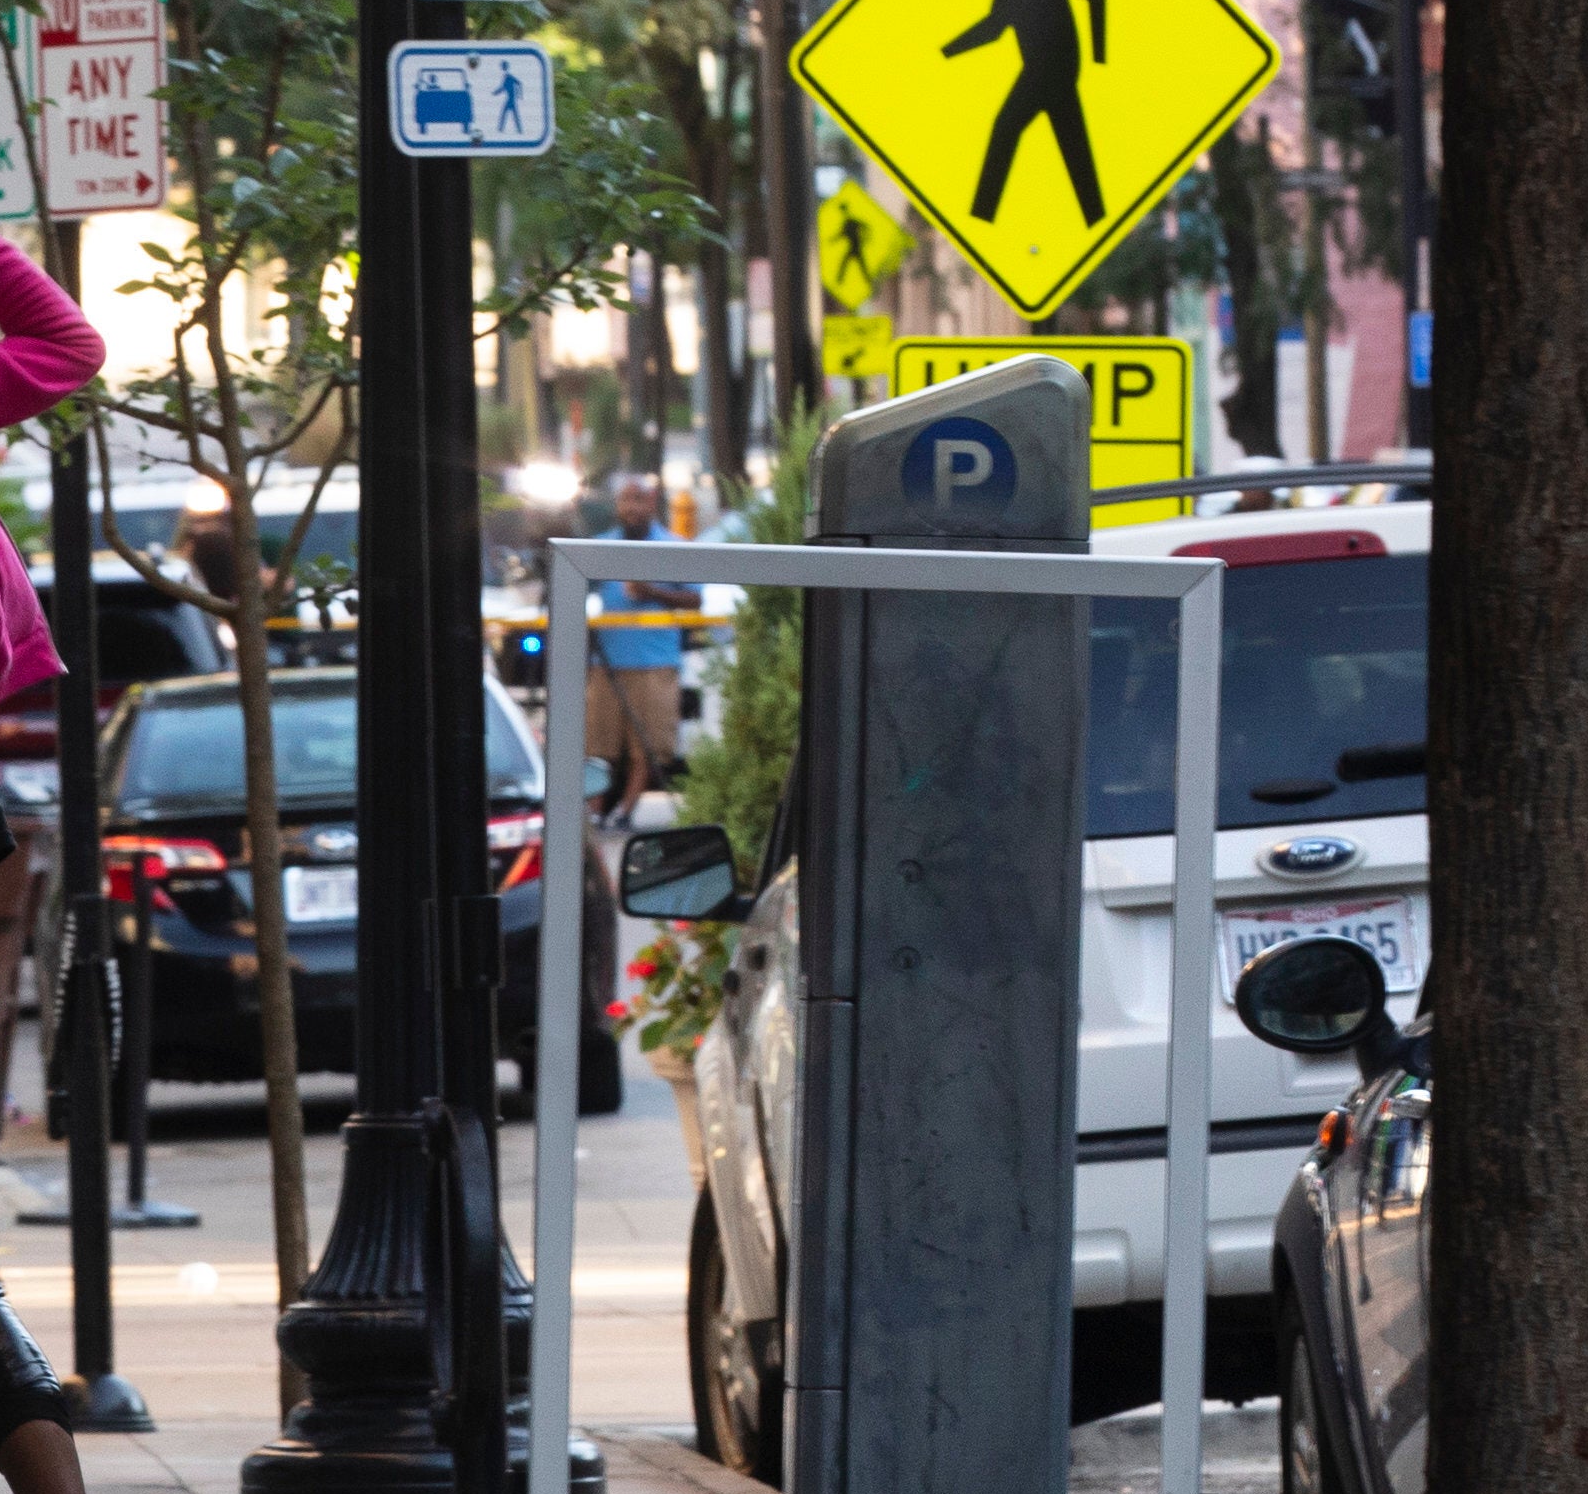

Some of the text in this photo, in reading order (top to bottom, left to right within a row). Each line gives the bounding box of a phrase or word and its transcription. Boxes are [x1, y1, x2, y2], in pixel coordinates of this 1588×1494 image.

[67, 56, 134, 102] ANY
[68, 113, 139, 158] TIME
[933, 438, 994, 508] P
